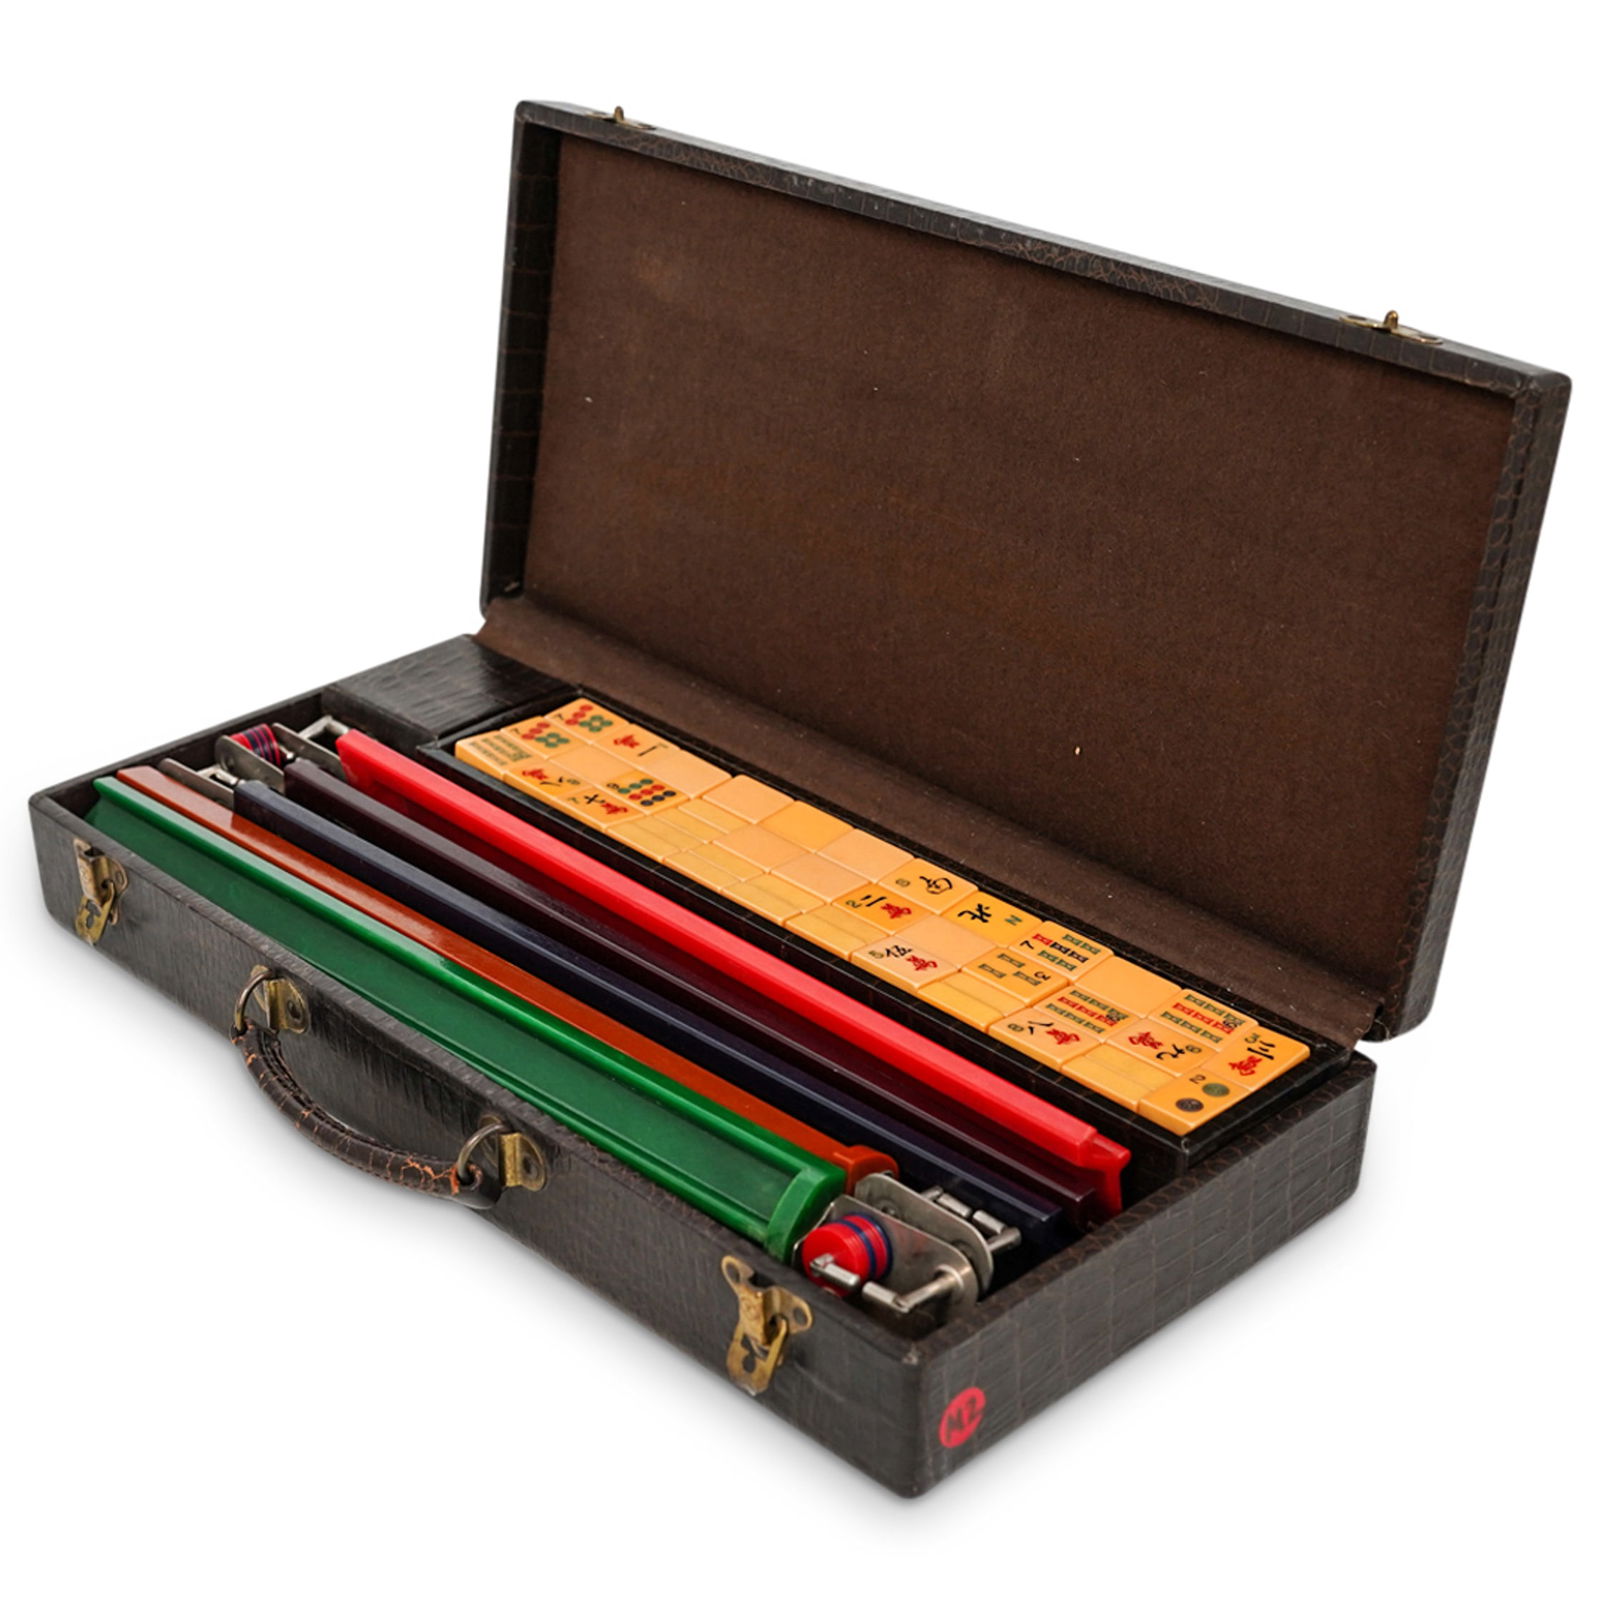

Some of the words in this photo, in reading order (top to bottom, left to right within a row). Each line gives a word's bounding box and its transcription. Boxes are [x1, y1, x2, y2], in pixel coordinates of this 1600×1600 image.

[845, 899, 862, 909] 2
[957, 903, 992, 923] 北
[1020, 940, 1034, 950] 7
[1007, 1023, 1024, 1032] 8
[1244, 1032, 1260, 1044] 3
[1189, 1074, 1206, 1085] 2
